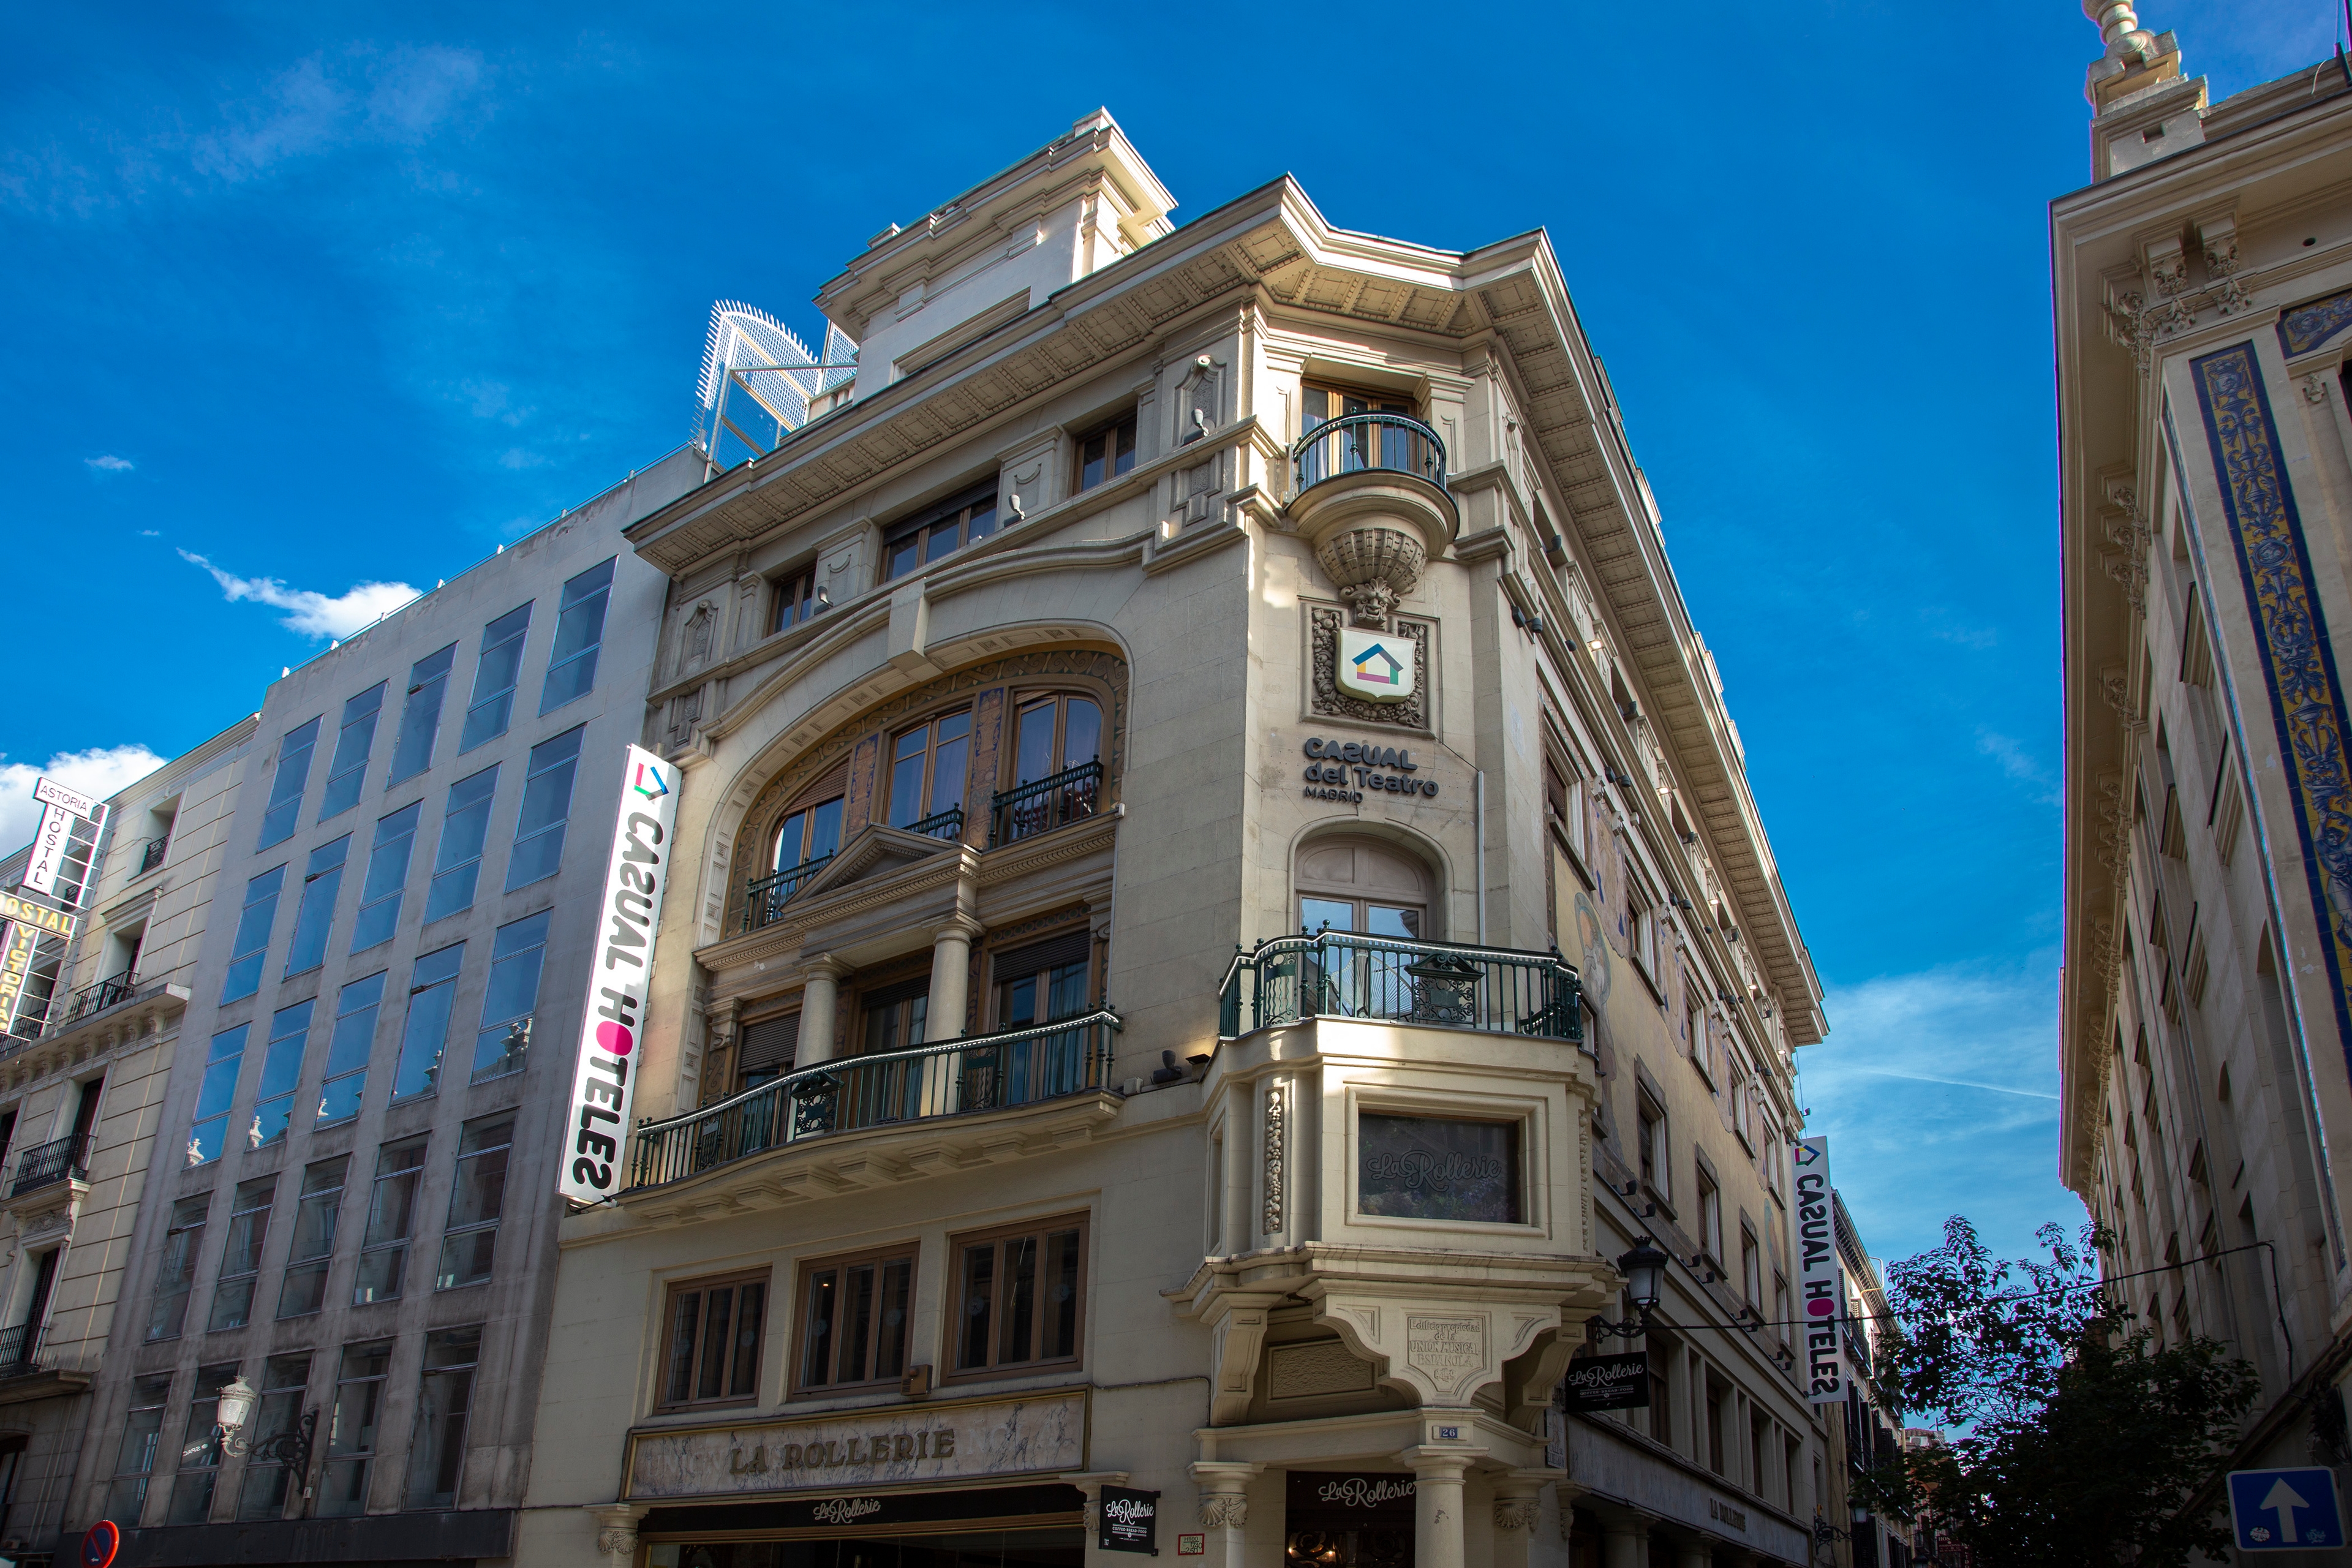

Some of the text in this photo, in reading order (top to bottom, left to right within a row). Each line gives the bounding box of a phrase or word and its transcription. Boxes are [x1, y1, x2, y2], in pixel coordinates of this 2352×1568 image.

[1305, 737, 1418, 771] CASUAL
[1305, 761, 1439, 796] del Teatro
[1305, 785, 1363, 804] MADRID
[40, 785, 87, 812] ASTORIA
[34, 807, 66, 885] HOSTAL
[0, 894, 71, 935] OSTAL
[571, 812, 665, 1190] CASUAL HOTELES
[1366, 1149, 1502, 1193] La Rollerie
[1796, 1174, 1840, 1396] CASUAL HOTELES
[1434, 1332, 1456, 1340] de la
[1568, 1363, 1644, 1387] La Rollerie
[1441, 1428, 1456, 1437] 26
[729, 1446, 767, 1474] LA
[782, 1428, 955, 1471] ROLLERIE
[1317, 1477, 1416, 1508] La Rollerie
[813, 1498, 882, 1524] La Rollerie
[1106, 1499, 1155, 1525] La Rollerie
